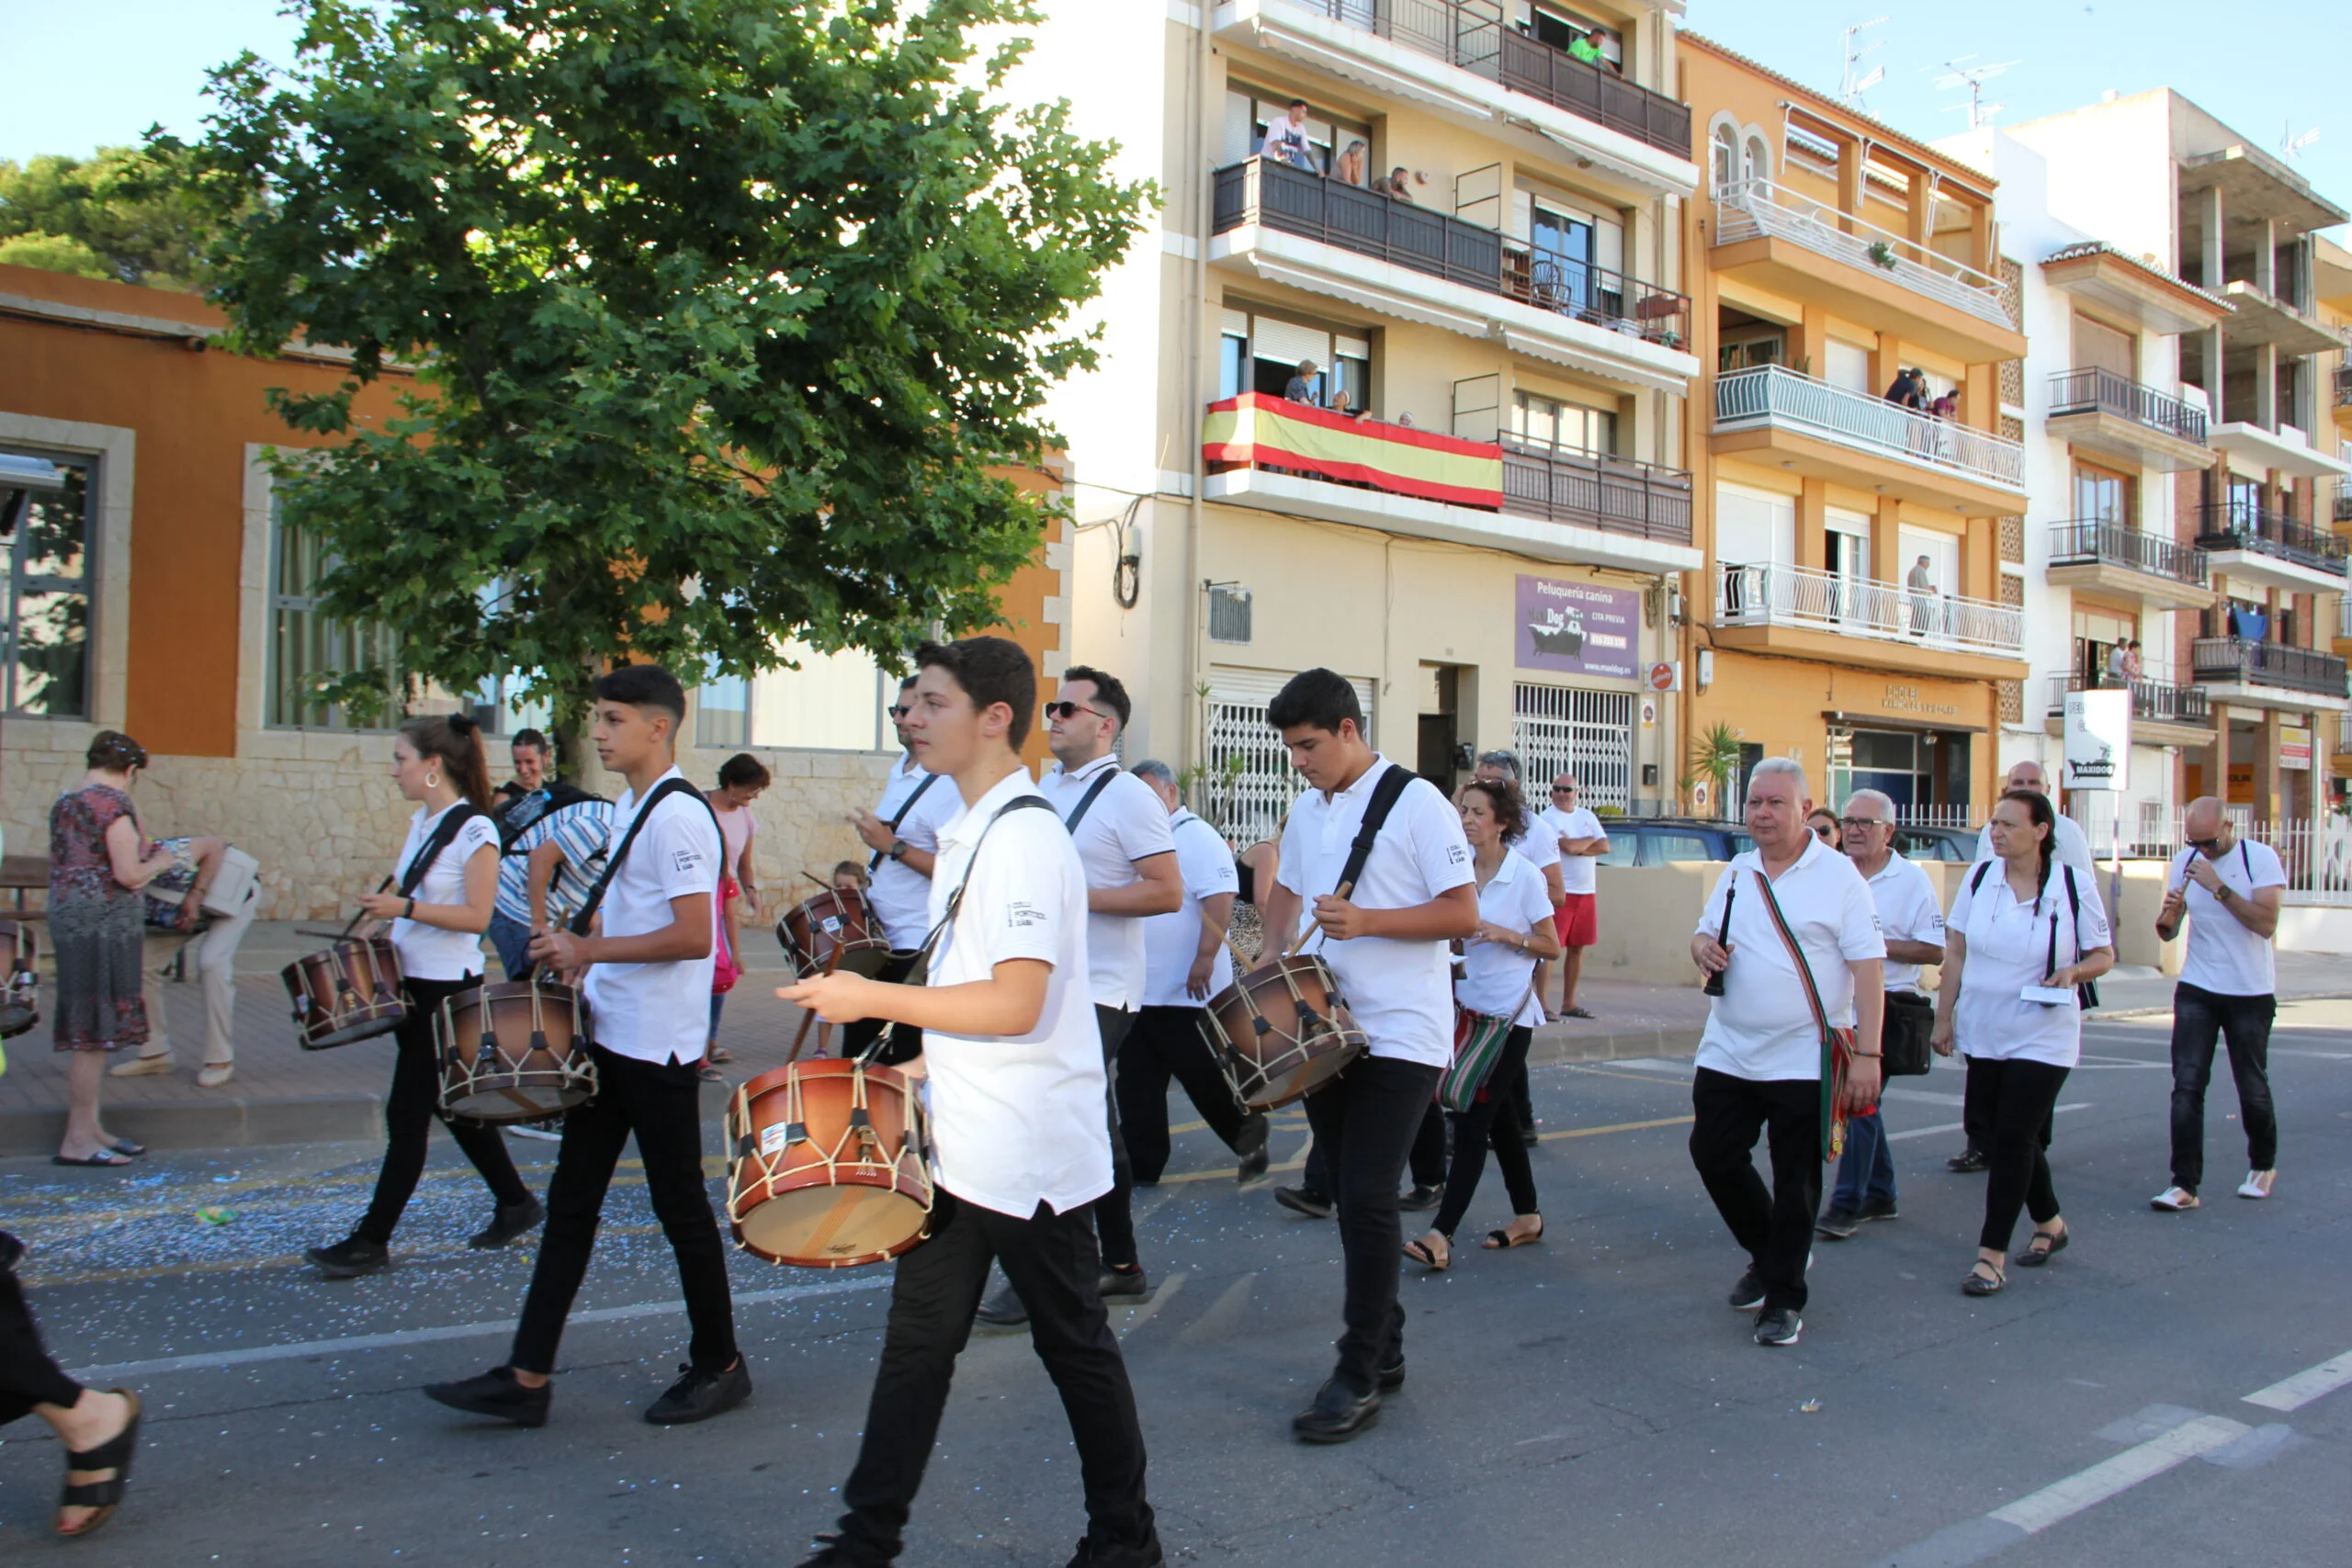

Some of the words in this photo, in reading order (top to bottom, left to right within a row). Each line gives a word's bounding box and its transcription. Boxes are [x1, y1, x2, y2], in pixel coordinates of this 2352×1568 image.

[1537, 581, 1584, 600] Peluquería
[1585, 591, 1613, 604] canina
[1591, 612, 1604, 622] CITA
[1605, 614, 1625, 624] PREVIA
[1584, 662, 1631, 675] www.maxidog.es
